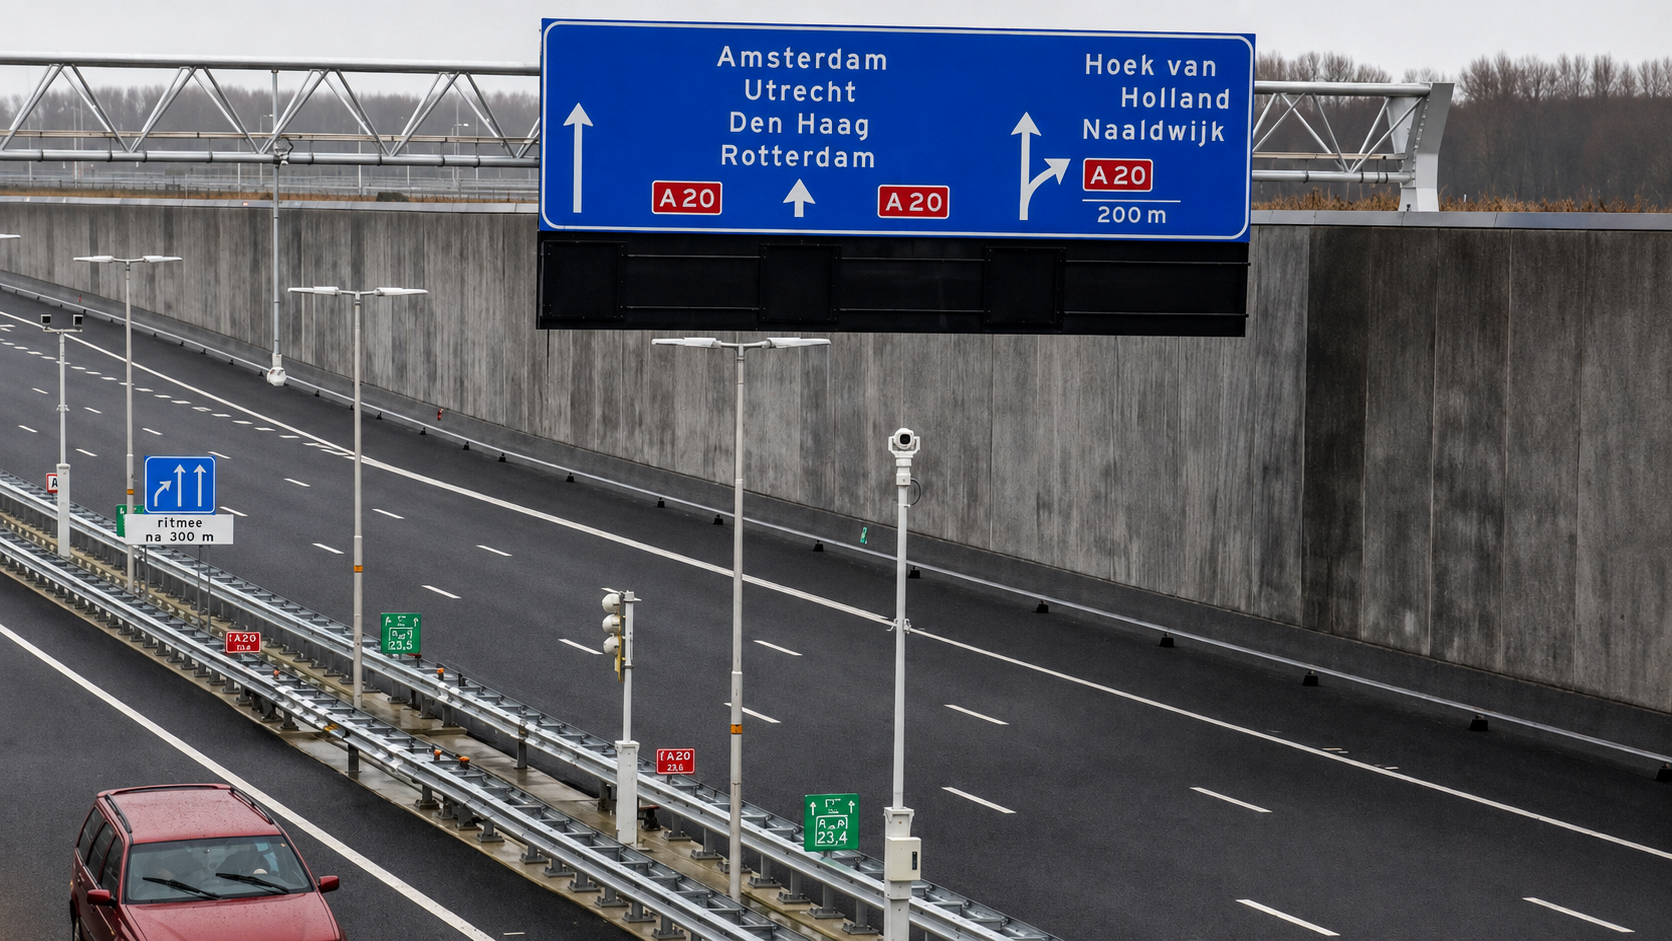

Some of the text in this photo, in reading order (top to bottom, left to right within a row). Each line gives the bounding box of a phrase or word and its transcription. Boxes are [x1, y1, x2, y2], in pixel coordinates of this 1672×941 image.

[716, 45, 887, 70] Amsterdam
[1085, 53, 1216, 77] Hoek van
[745, 79, 856, 102] Utrecht
[1121, 87, 1230, 109] Holland
[730, 111, 869, 141] Den Haag
[1083, 118, 1225, 147] Naaldwijk
[721, 144, 875, 168] Rotterdam
[1097, 206, 1167, 224] 200 m
[157, 517, 203, 528] ritmee
[145, 531, 214, 542] na 300 m
[817, 830, 848, 846] 23,4
